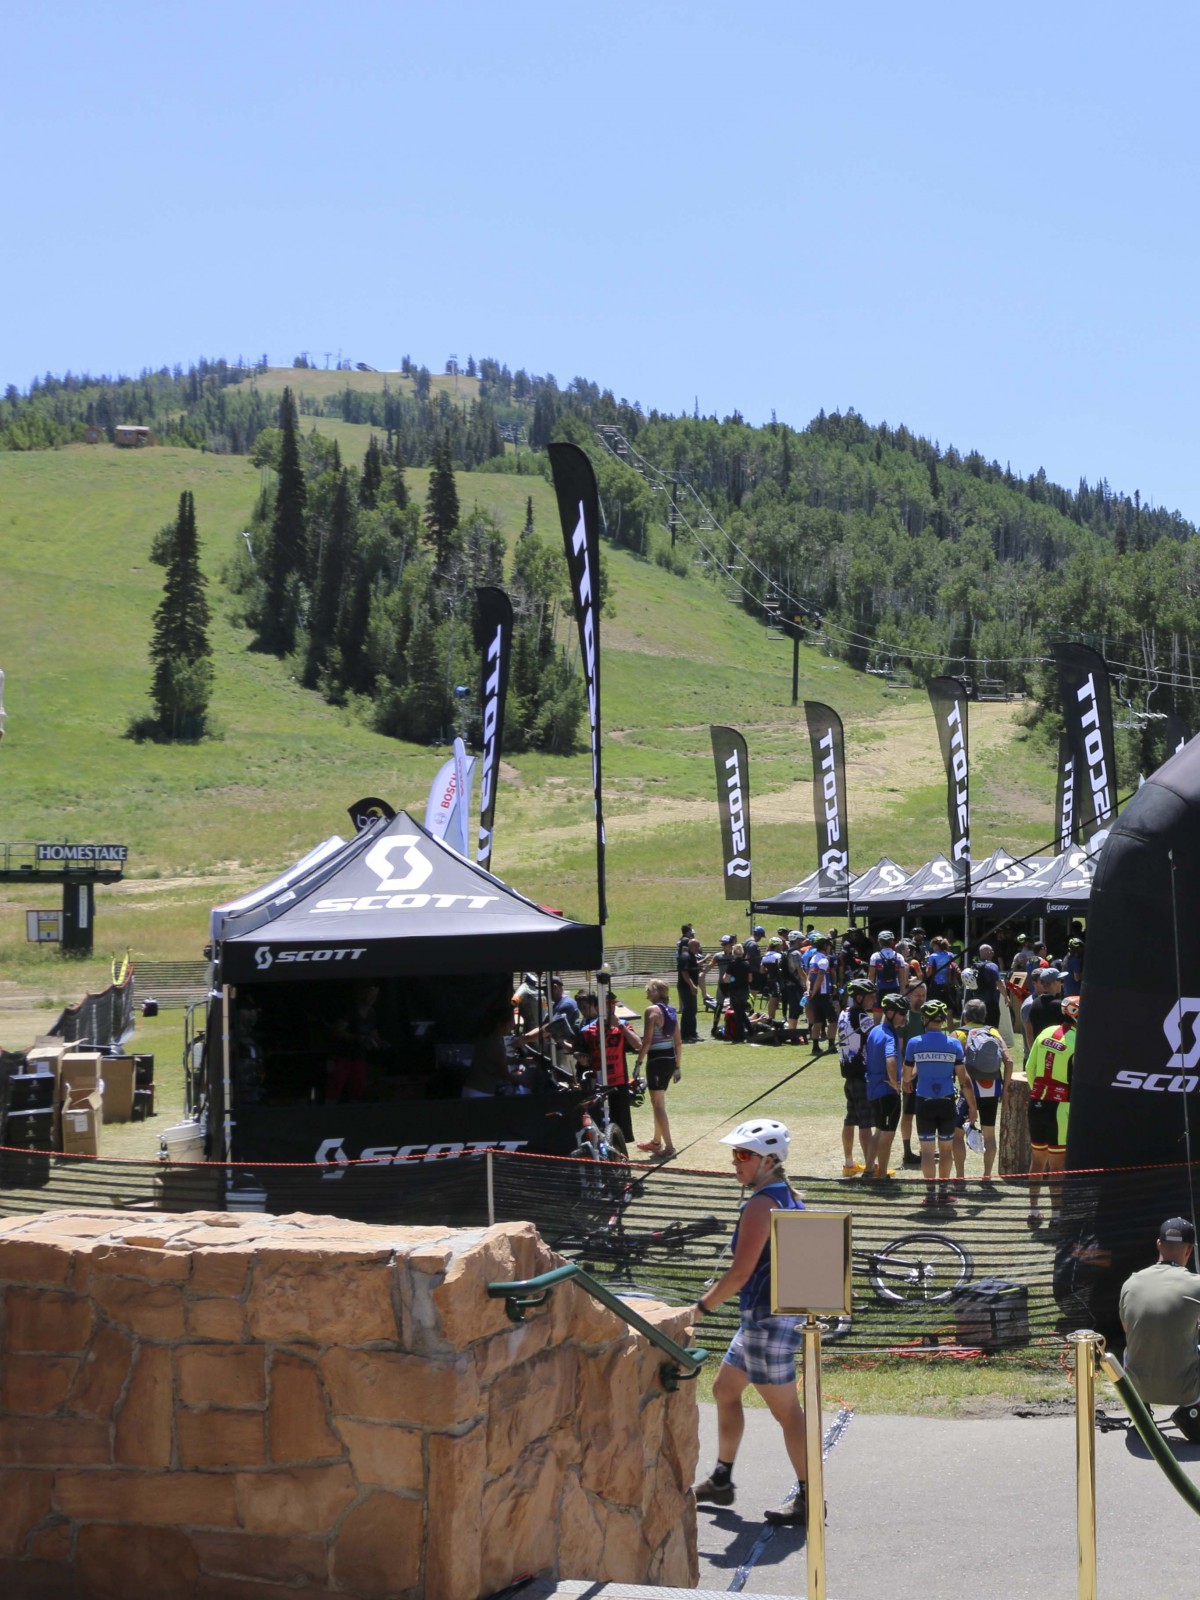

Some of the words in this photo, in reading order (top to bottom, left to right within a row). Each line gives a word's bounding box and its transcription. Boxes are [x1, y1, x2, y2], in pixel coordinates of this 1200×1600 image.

[39, 846, 126, 859] HOMESTAKE
[309, 893, 500, 913] SCOTT
[274, 948, 367, 962] SCOTT
[1044, 1038, 1063, 1050] ELITE
[917, 1053, 954, 1061] MARTY'S
[355, 1140, 529, 1167] SCOTT
